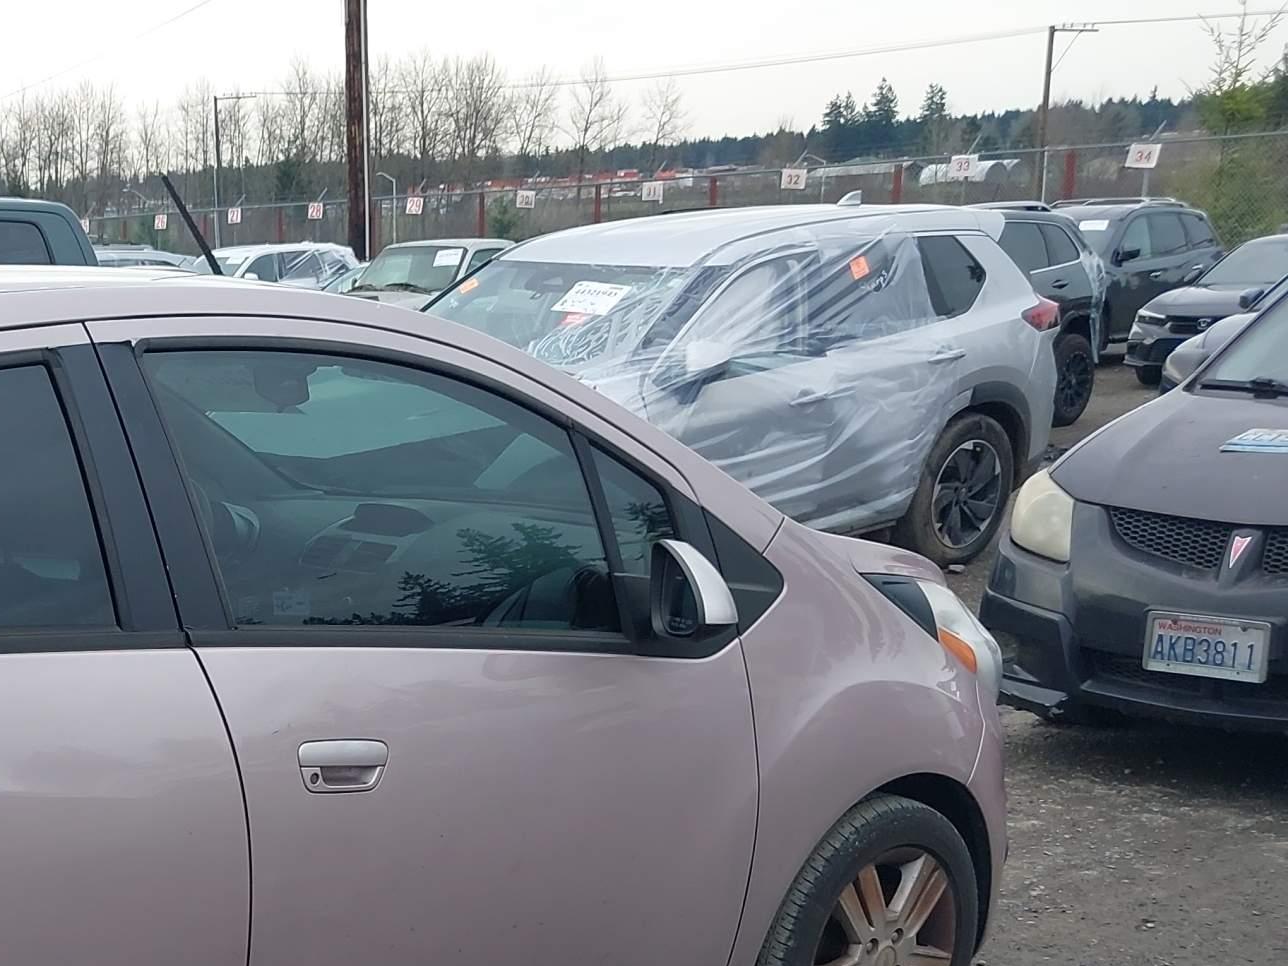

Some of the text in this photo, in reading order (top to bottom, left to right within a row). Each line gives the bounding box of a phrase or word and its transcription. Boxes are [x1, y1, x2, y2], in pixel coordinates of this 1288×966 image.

[1135, 150, 1153, 162] 34
[1158, 621, 1223, 636] WASHINGTON
[1153, 633, 1255, 670] AKB3811
